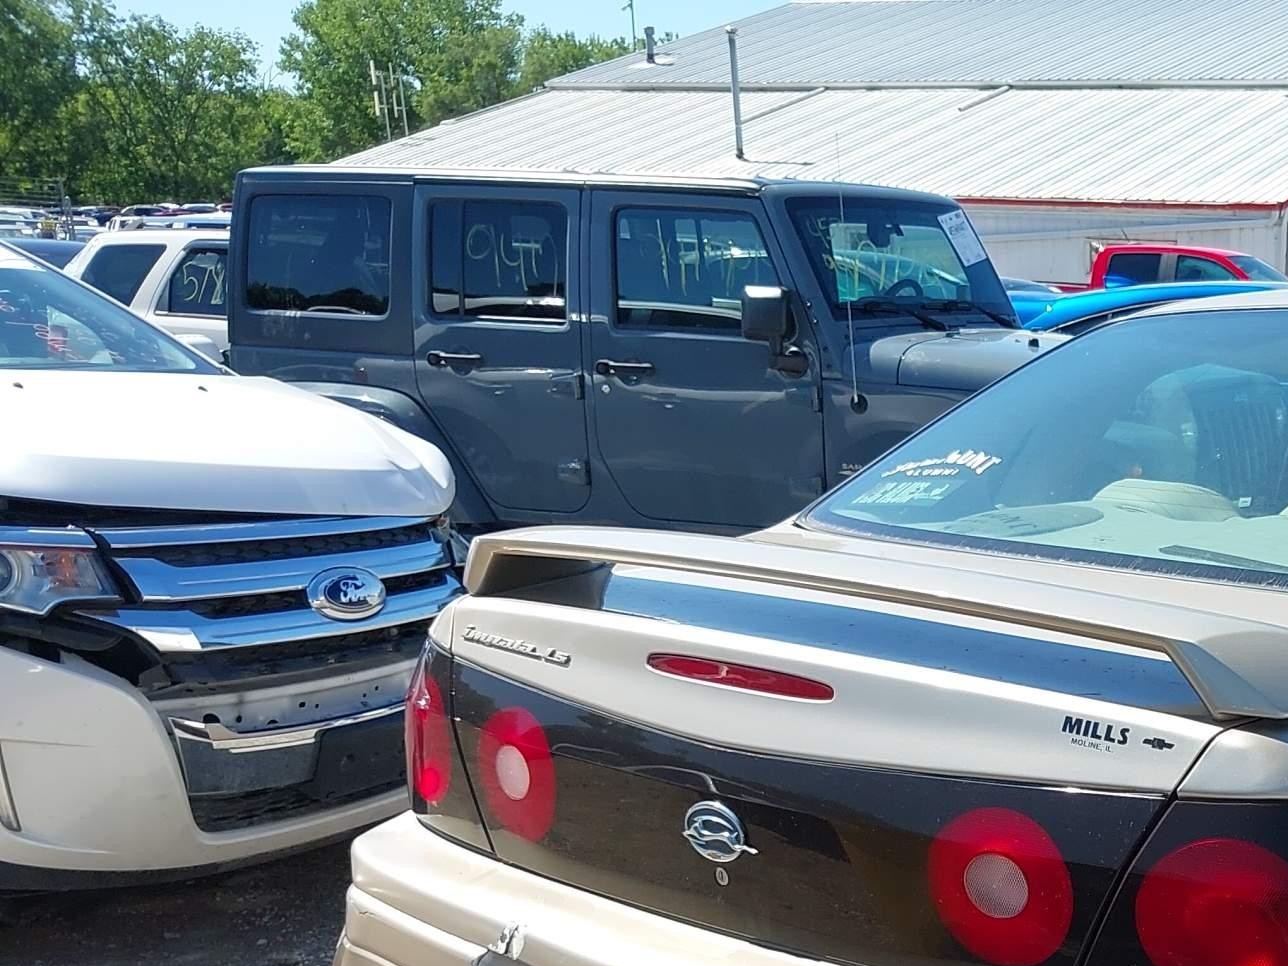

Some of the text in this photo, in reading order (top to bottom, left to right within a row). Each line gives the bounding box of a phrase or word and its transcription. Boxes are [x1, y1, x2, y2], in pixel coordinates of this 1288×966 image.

[462, 624, 571, 668] Impala LS
[1061, 715, 1130, 746] MILLS
[1070, 737, 1103, 752] MOLINE,
